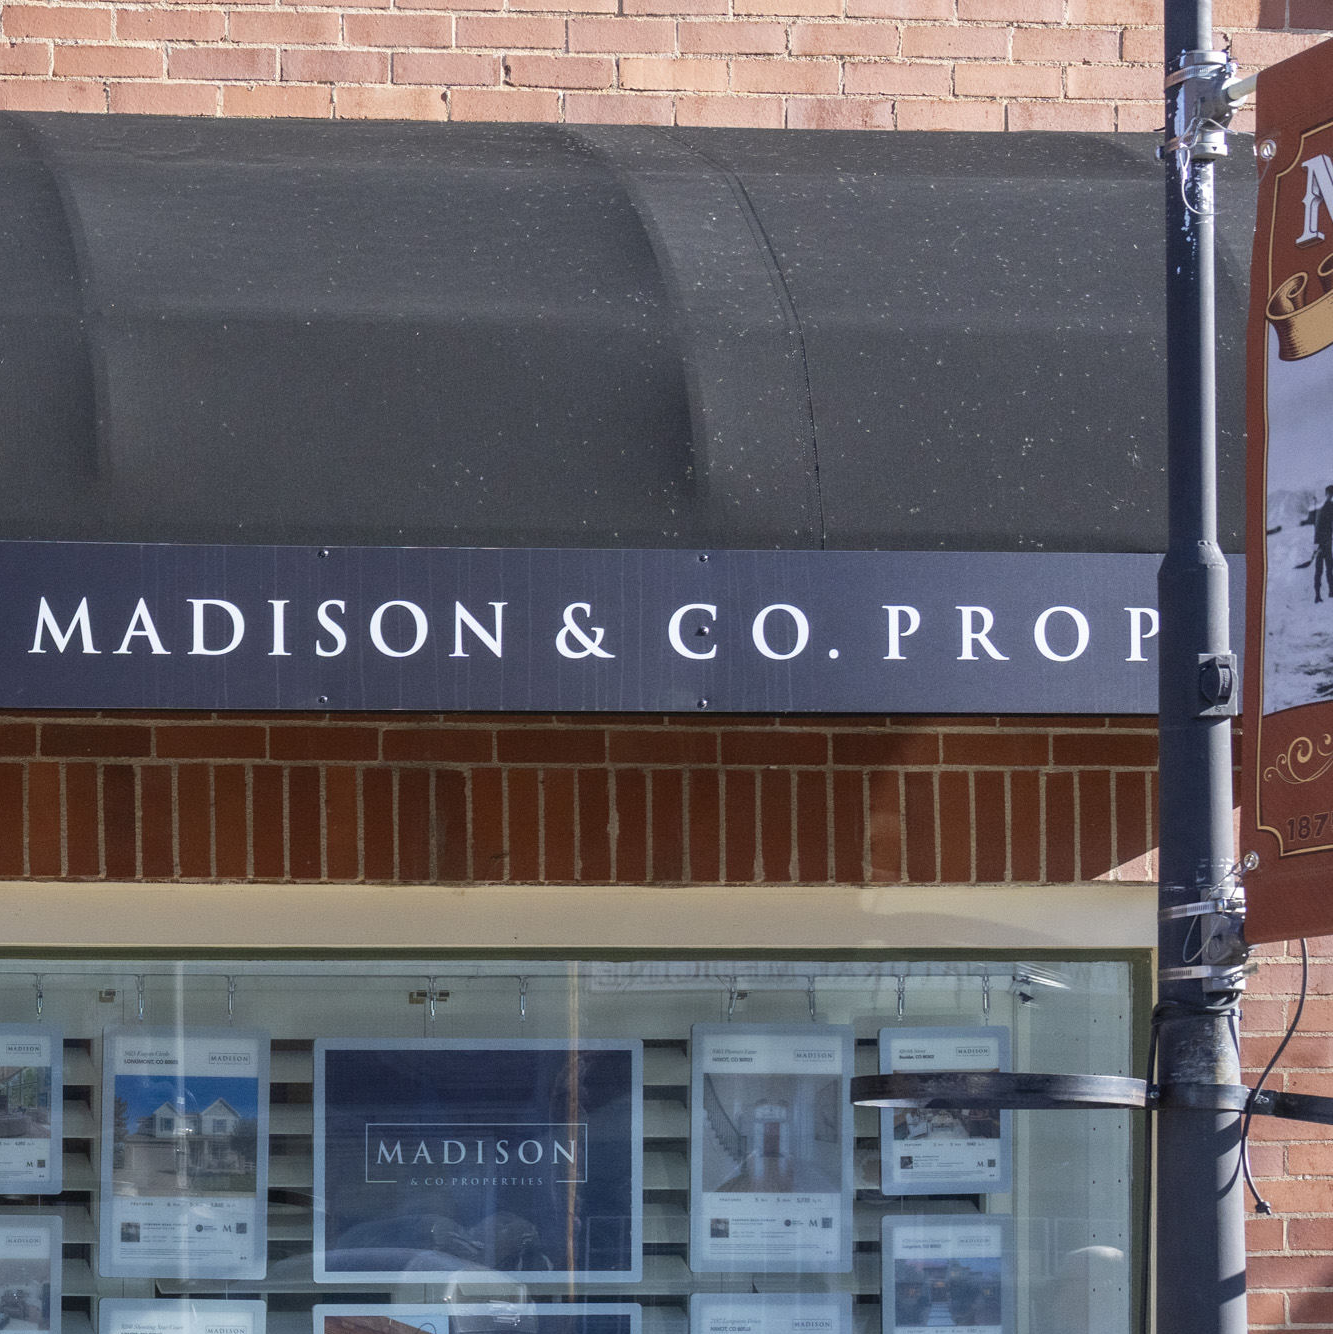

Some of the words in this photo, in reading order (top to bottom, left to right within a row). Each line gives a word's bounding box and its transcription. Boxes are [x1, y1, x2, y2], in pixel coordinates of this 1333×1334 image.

[27, 596, 507, 659] MADISON
[554, 601, 616, 660] &
[1287, 812, 1332, 842] 187
[375, 1140, 576, 1165] MADISON
